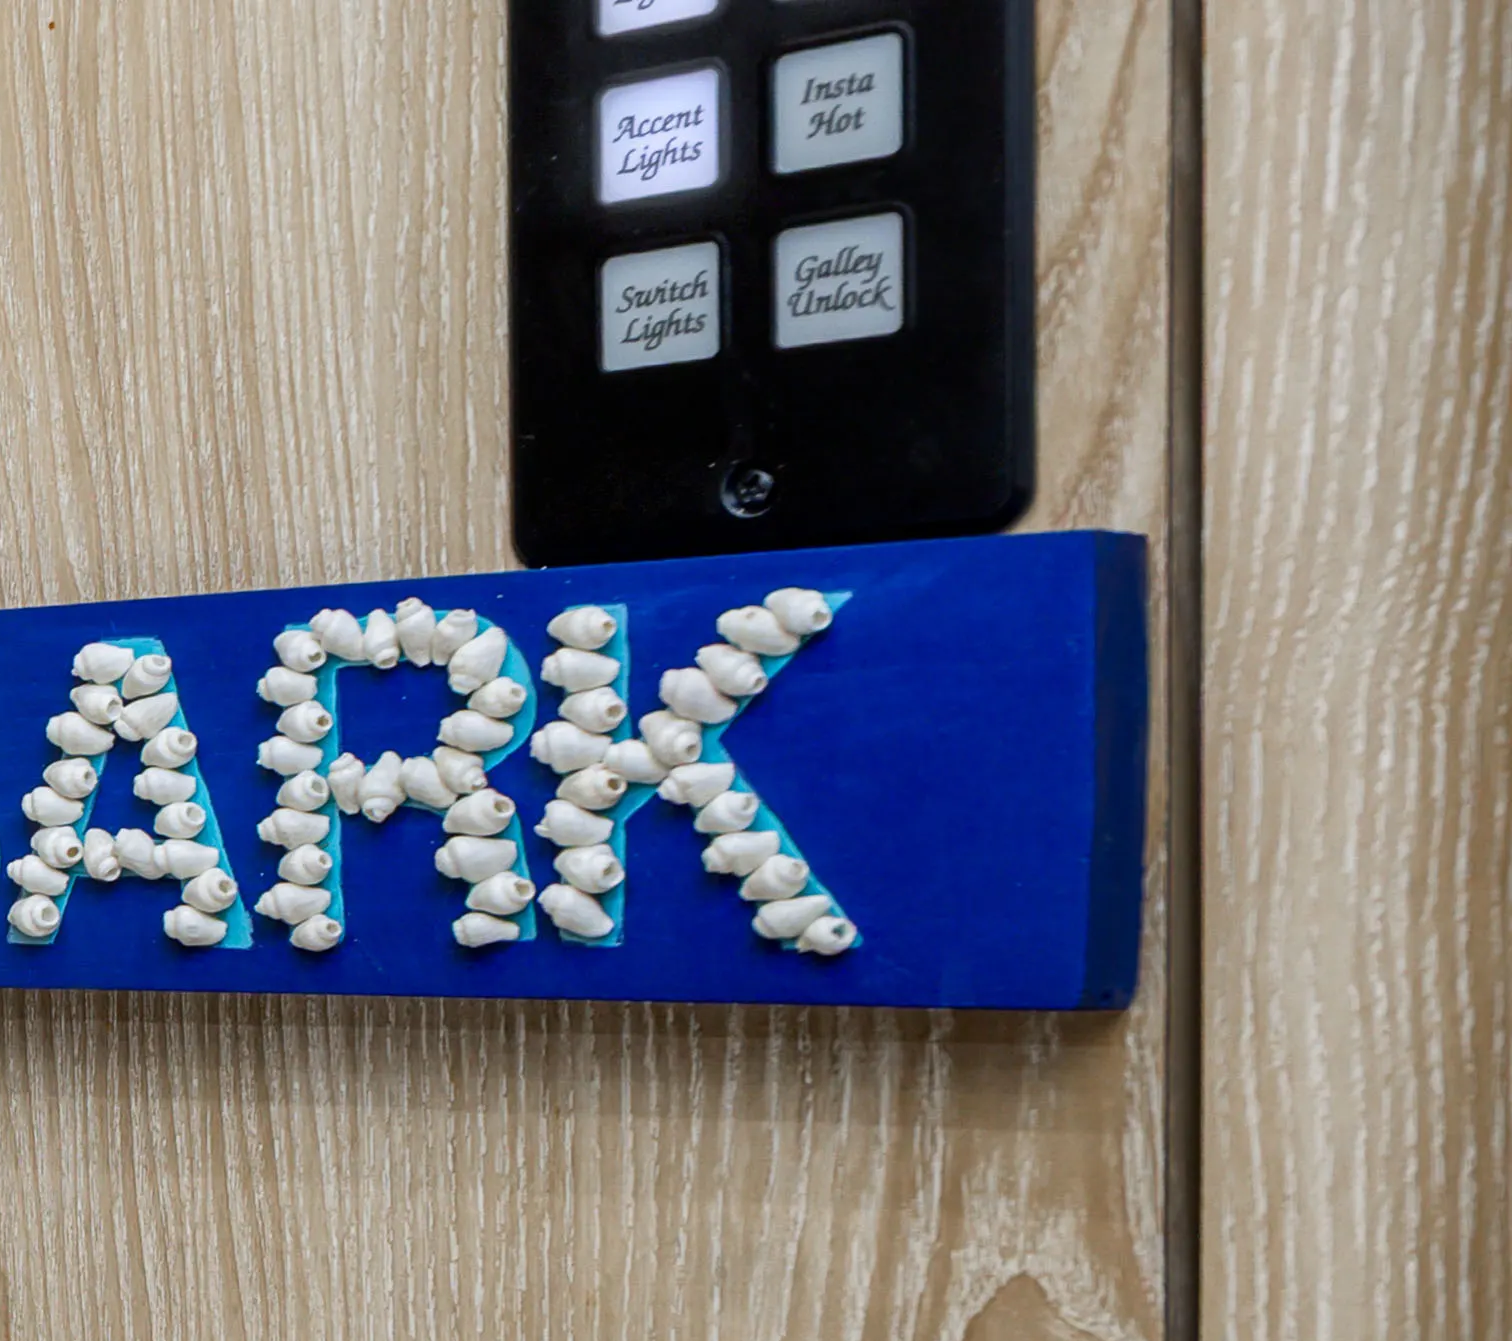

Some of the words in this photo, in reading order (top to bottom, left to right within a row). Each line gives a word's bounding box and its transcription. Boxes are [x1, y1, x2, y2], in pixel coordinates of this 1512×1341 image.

[801, 72, 876, 105] Insta
[612, 104, 705, 143] Accent
[806, 104, 867, 140] Hot
[616, 137, 703, 182] Lights
[795, 245, 883, 290] Galley
[616, 270, 709, 313] Switch
[786, 276, 895, 318] Unlock
[620, 307, 708, 351] Lights
